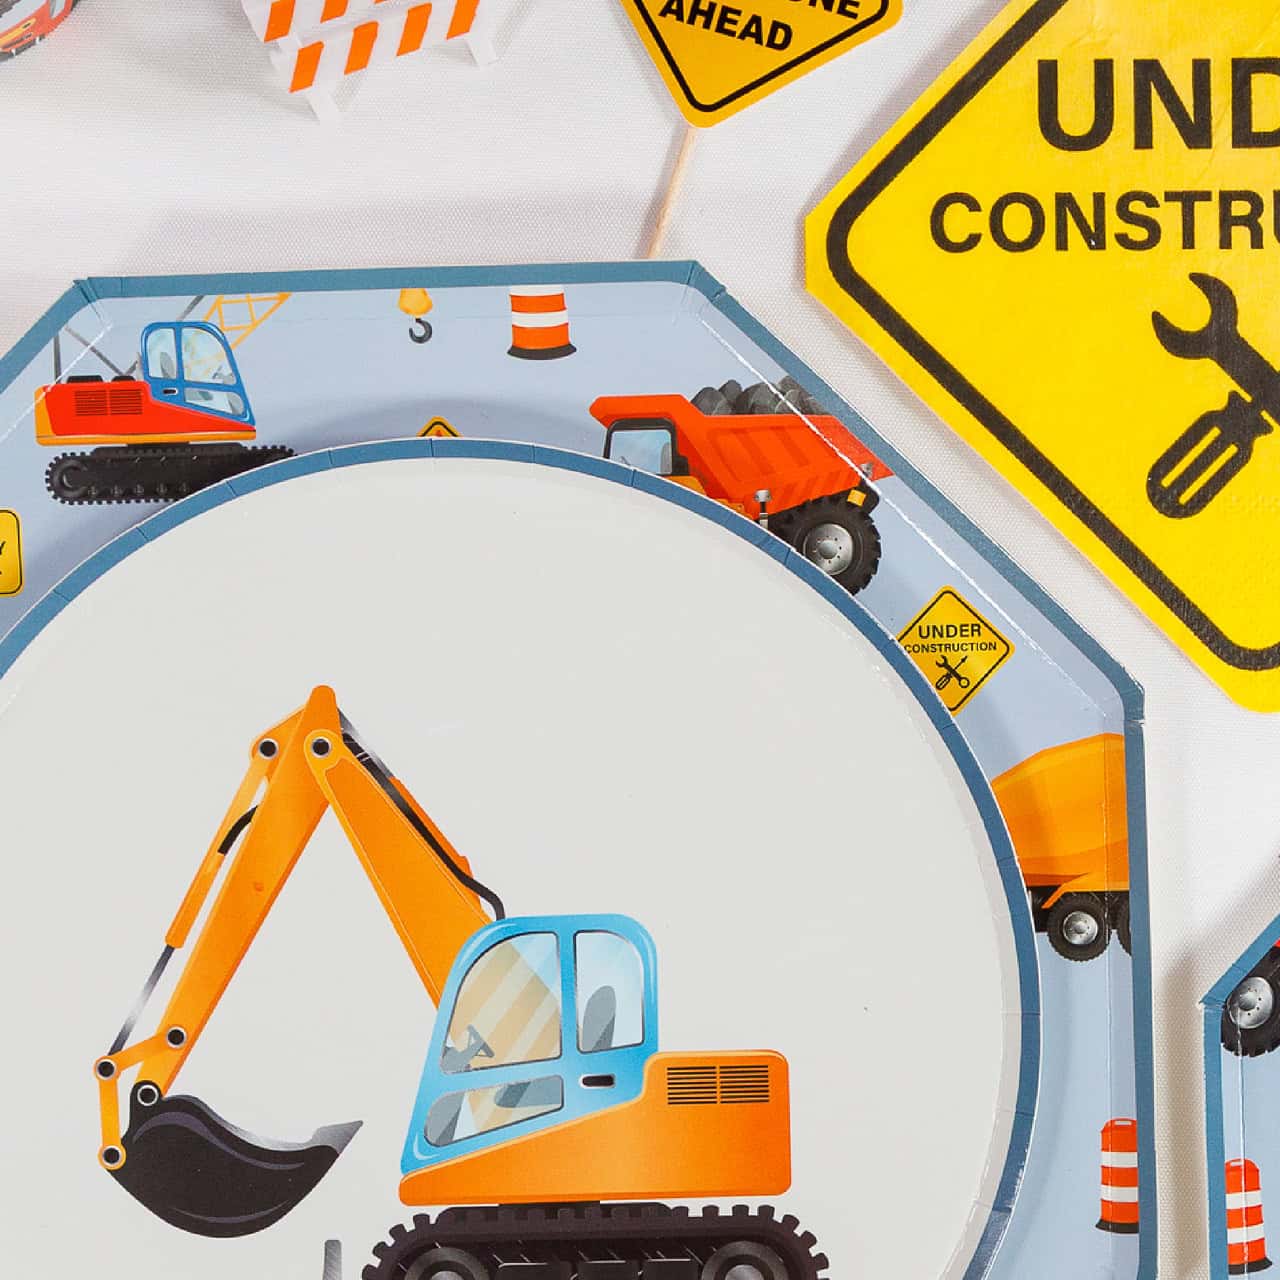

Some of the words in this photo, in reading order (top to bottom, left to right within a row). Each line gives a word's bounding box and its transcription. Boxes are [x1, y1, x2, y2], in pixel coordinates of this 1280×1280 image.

[659, 0, 793, 51] AHEAD
[918, 623, 981, 640] UNDER
[904, 641, 997, 654] CONSTRUCTION
